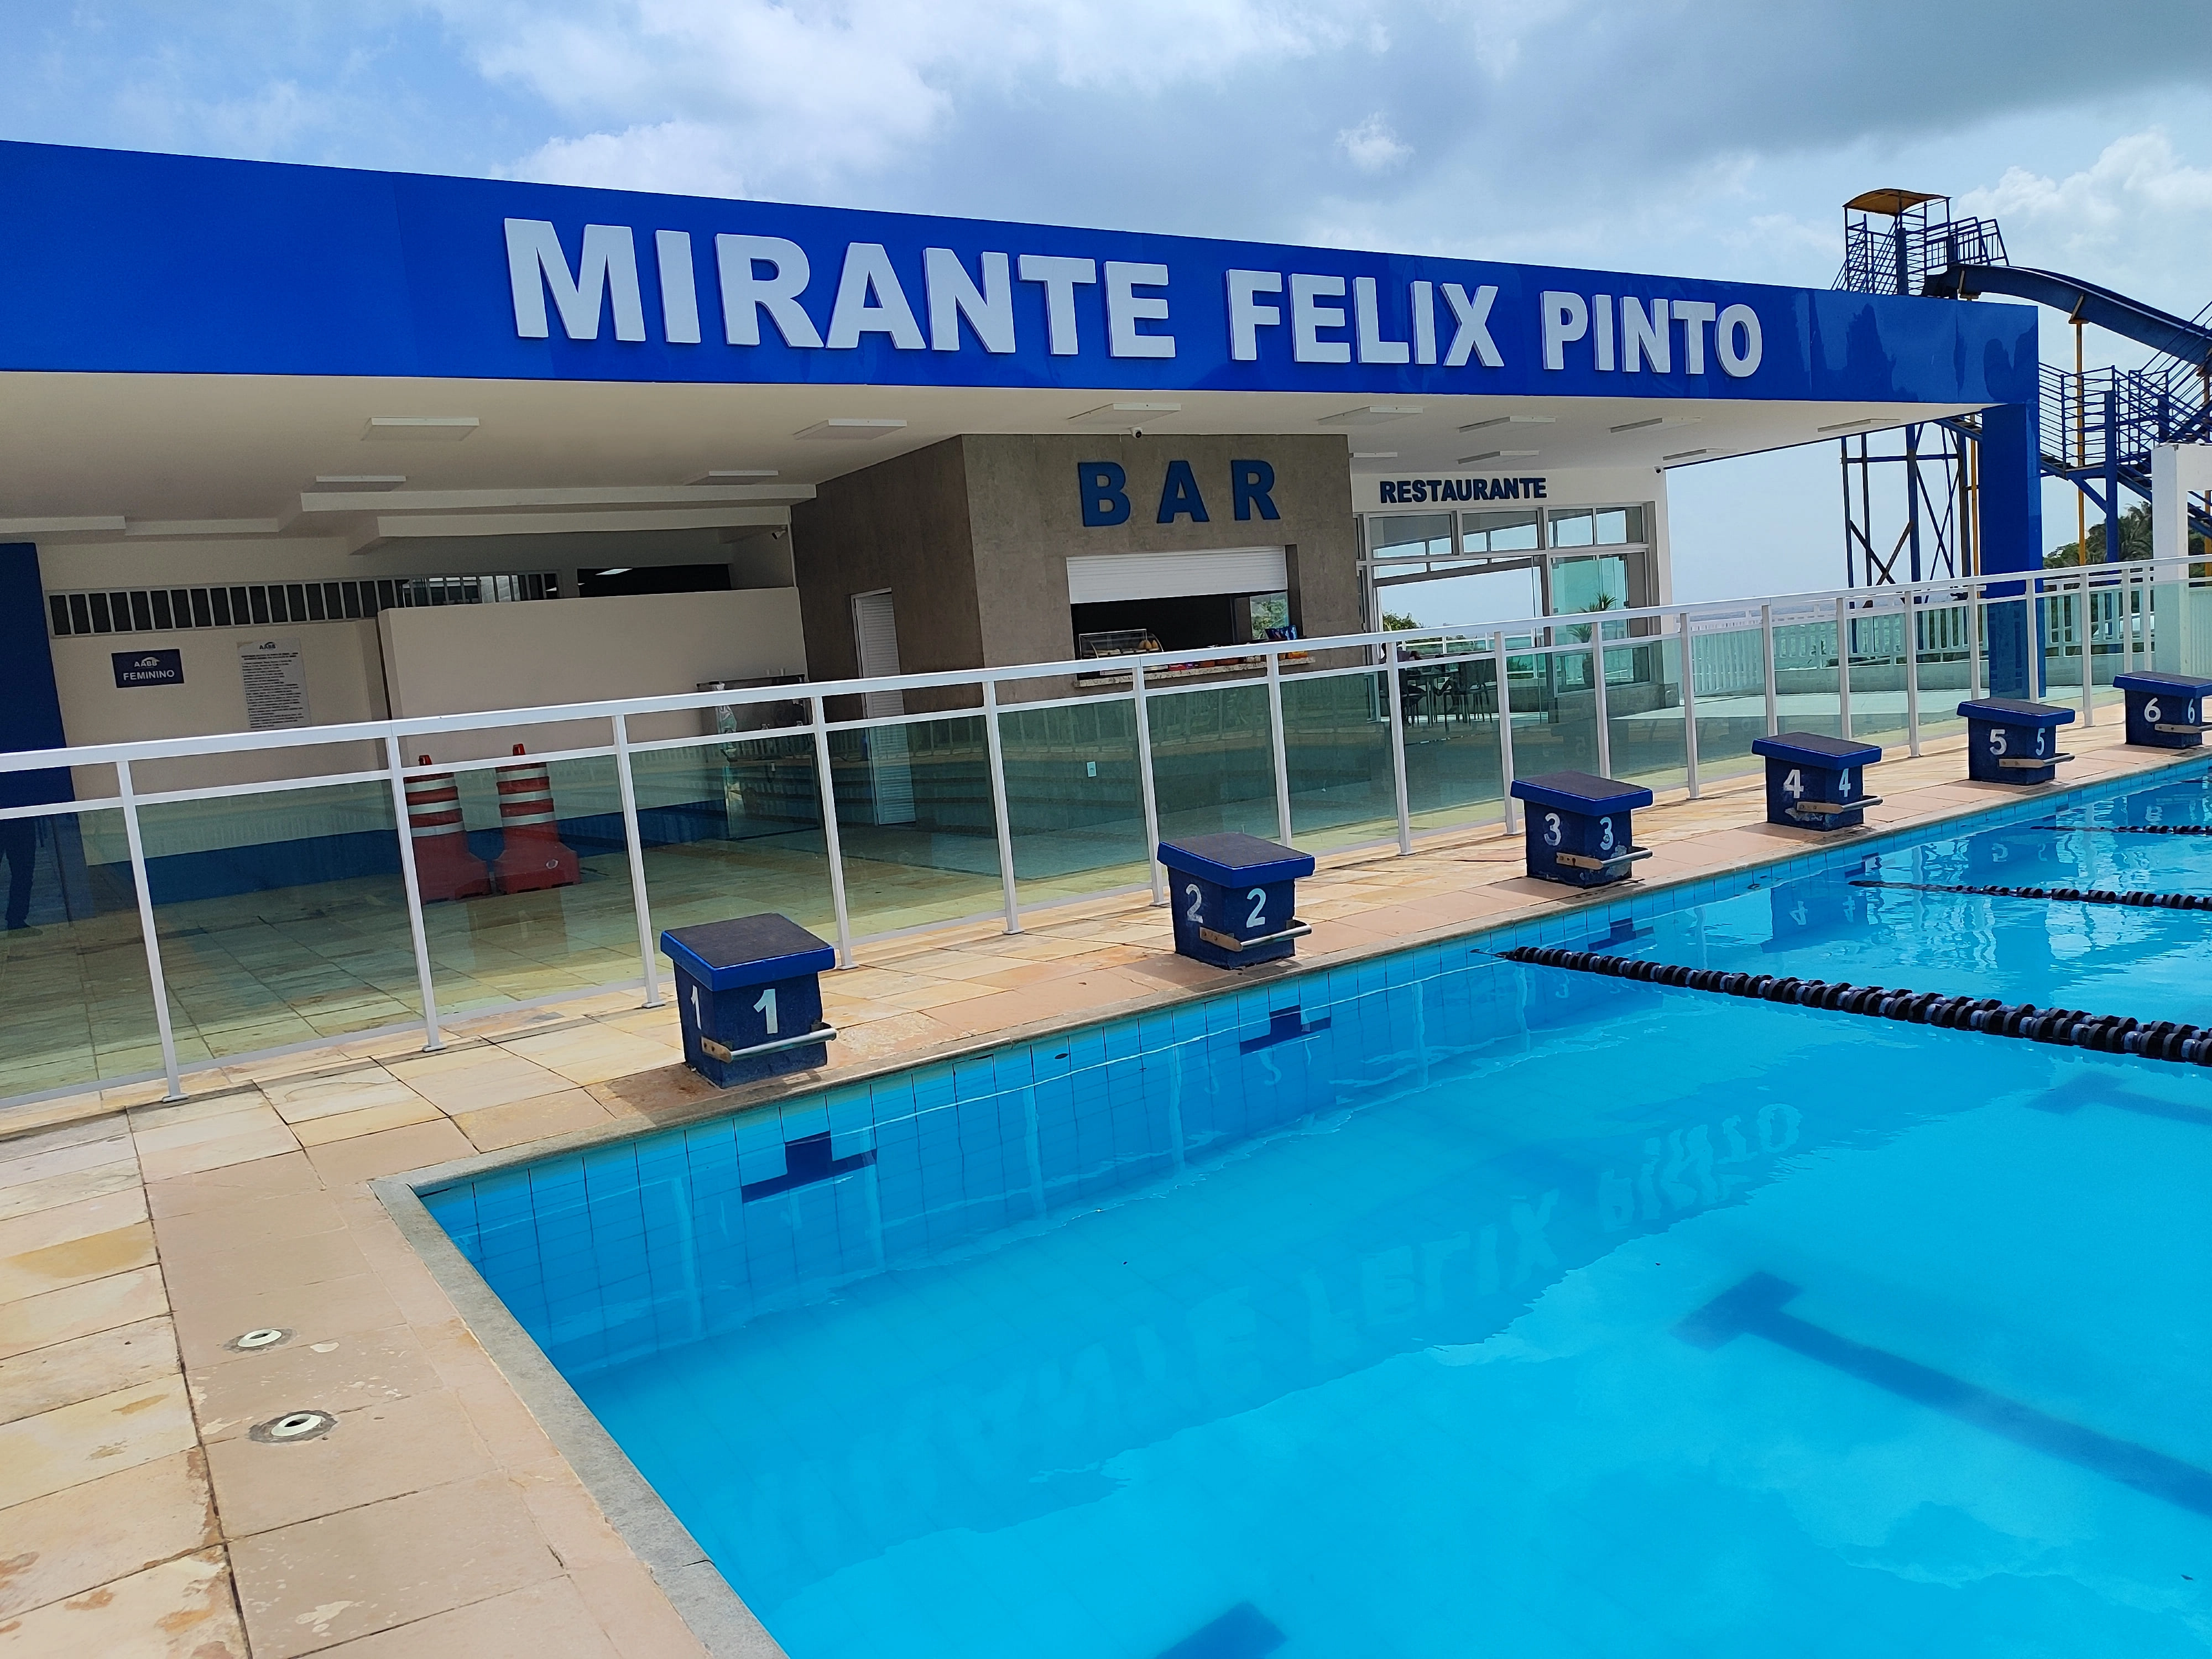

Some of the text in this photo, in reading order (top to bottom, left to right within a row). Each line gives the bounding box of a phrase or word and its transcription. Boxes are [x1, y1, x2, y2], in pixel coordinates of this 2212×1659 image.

[503, 217, 1763, 378] MIRANTE FELIX PINTO
[1077, 459, 1281, 528] BAR
[1379, 477, 1547, 504] RESTAURANTE
[123, 670, 175, 681] FEMININO
[134, 658, 158, 667] AABB
[2143, 697, 2162, 722] 6
[2188, 698, 2195, 724] 6
[1990, 729, 2007, 755] 5
[2036, 728, 2046, 756] 5
[1783, 769, 1804, 799] 4
[1839, 768, 1851, 797] 4
[1543, 812, 1562, 846] 3
[1599, 816, 1614, 851] 3
[1185, 884, 1203, 924] 2
[1246, 888, 1266, 928] 2
[691, 984, 702, 1030] 1
[753, 988, 778, 1035] 1
